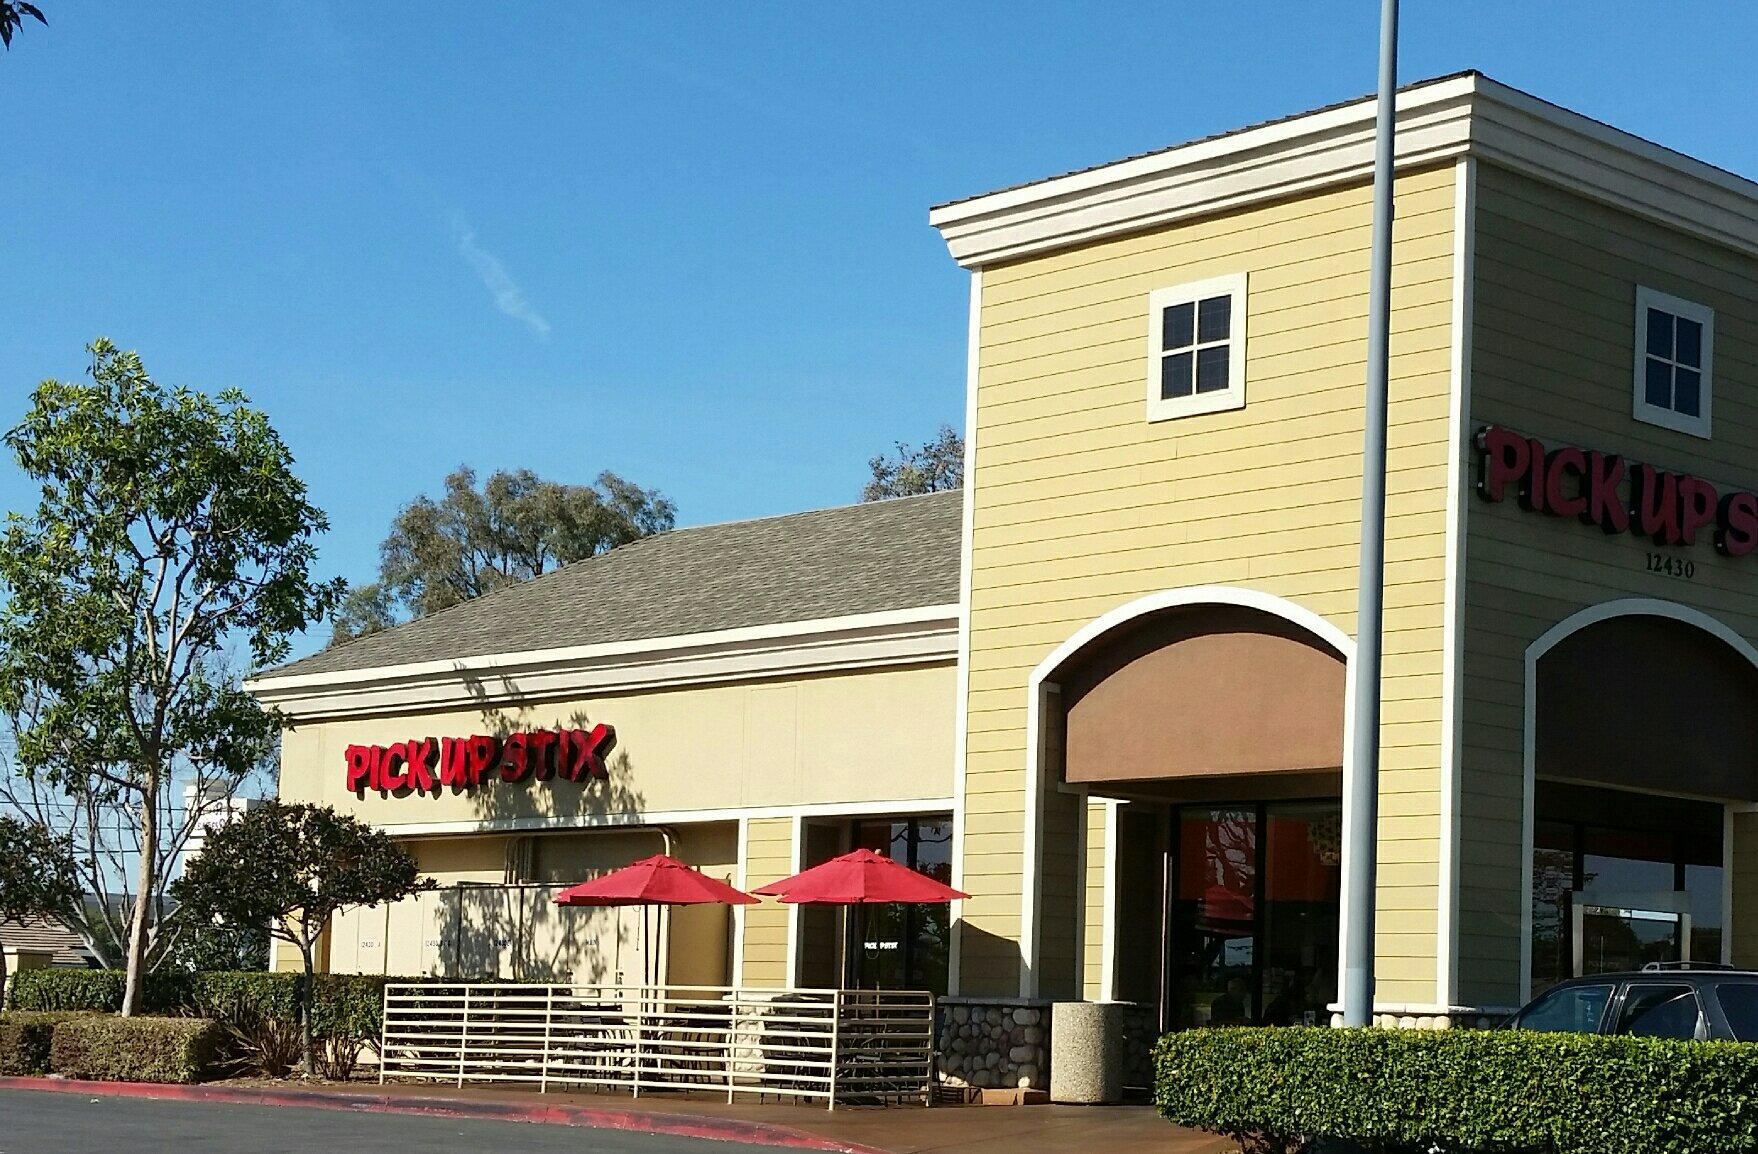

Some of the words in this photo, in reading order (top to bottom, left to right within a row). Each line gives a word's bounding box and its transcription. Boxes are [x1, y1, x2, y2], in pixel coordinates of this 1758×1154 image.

[1475, 424, 1629, 534] PICK
[1635, 463, 1718, 546] UP
[1646, 553, 1695, 579] 12430
[345, 737, 438, 792] PICK
[440, 734, 496, 787] UP
[500, 724, 617, 784] STIX
